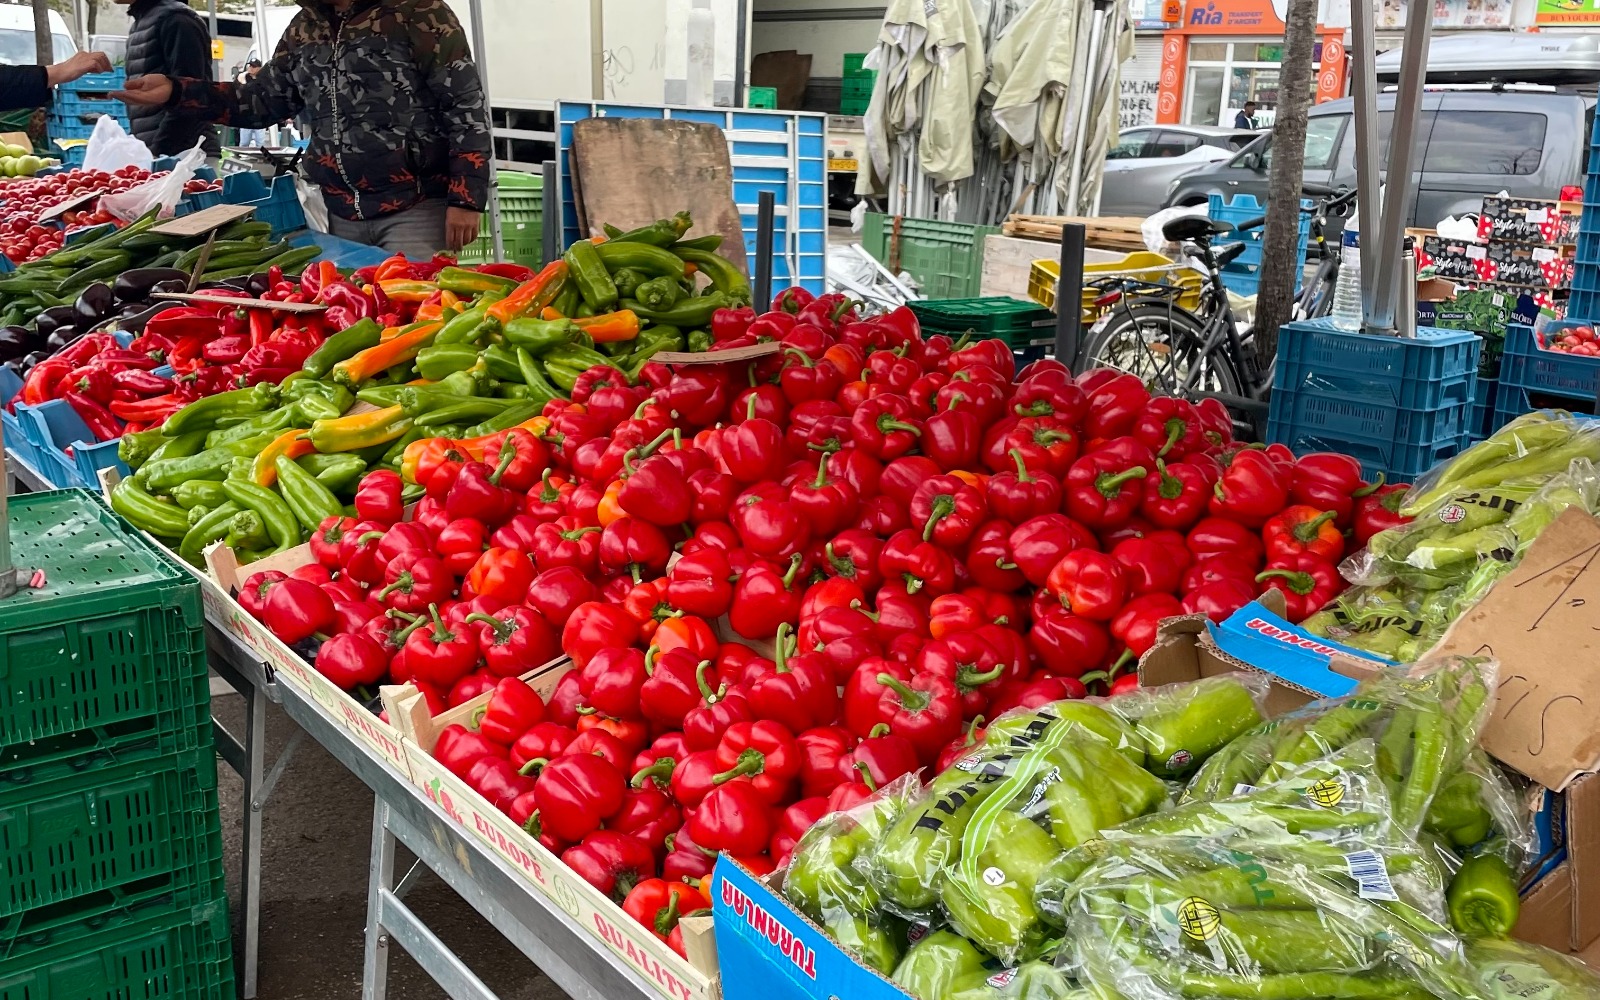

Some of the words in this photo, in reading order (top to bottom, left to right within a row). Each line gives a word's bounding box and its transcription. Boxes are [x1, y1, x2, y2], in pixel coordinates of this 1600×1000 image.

[1190, 1, 1223, 25] Ria
[339, 700, 400, 762] QUALITY
[472, 811, 546, 885] EUROPE
[593, 912, 693, 1000] QUALITY
[721, 875, 817, 981] TURANLAR
